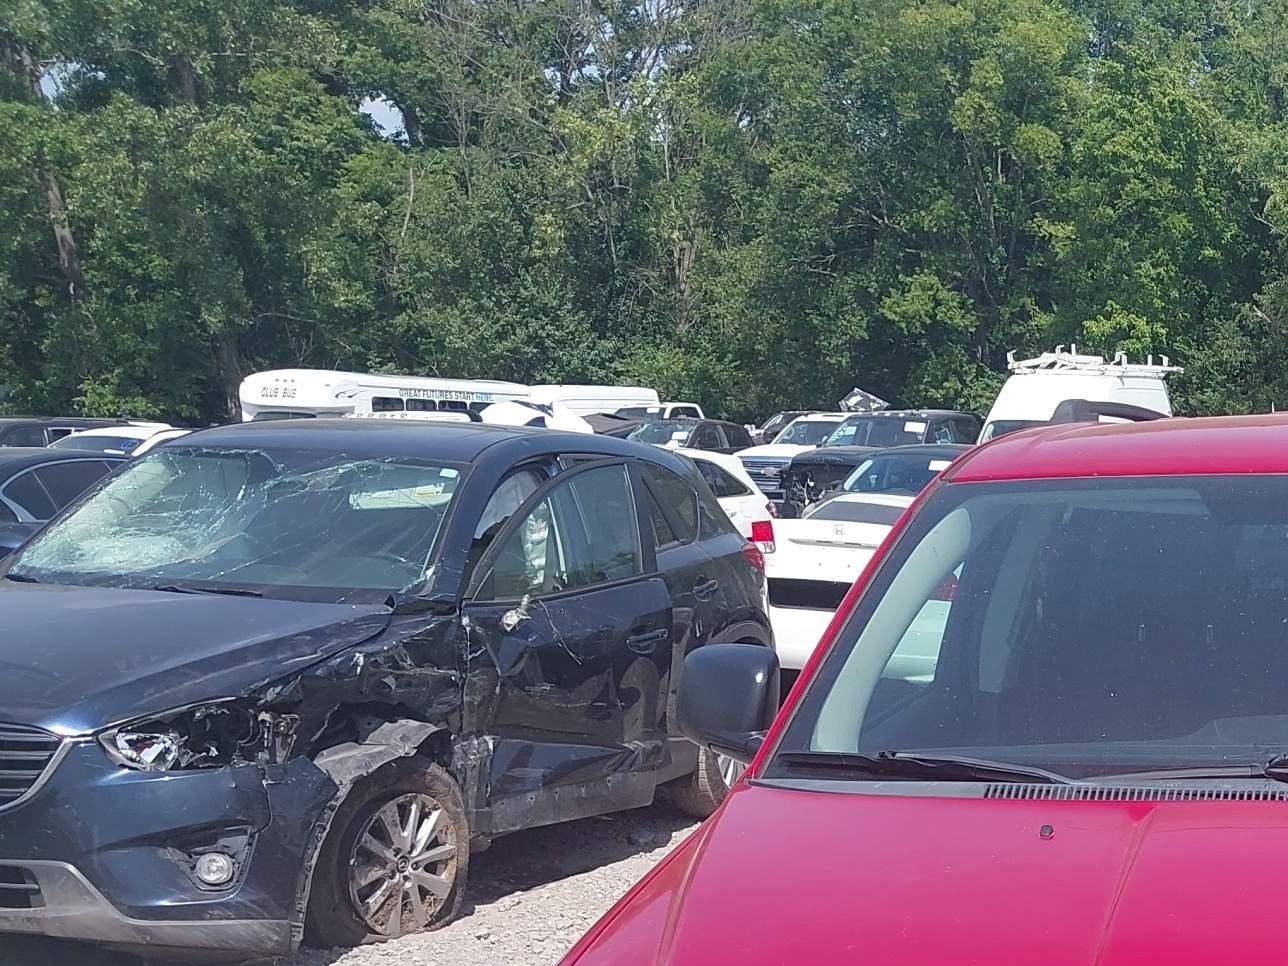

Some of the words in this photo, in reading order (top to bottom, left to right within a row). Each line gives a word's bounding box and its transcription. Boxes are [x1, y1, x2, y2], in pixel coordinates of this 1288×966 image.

[399, 387, 420, 398] GREAT
[422, 388, 453, 400] FUTURES
[454, 390, 474, 401] START
